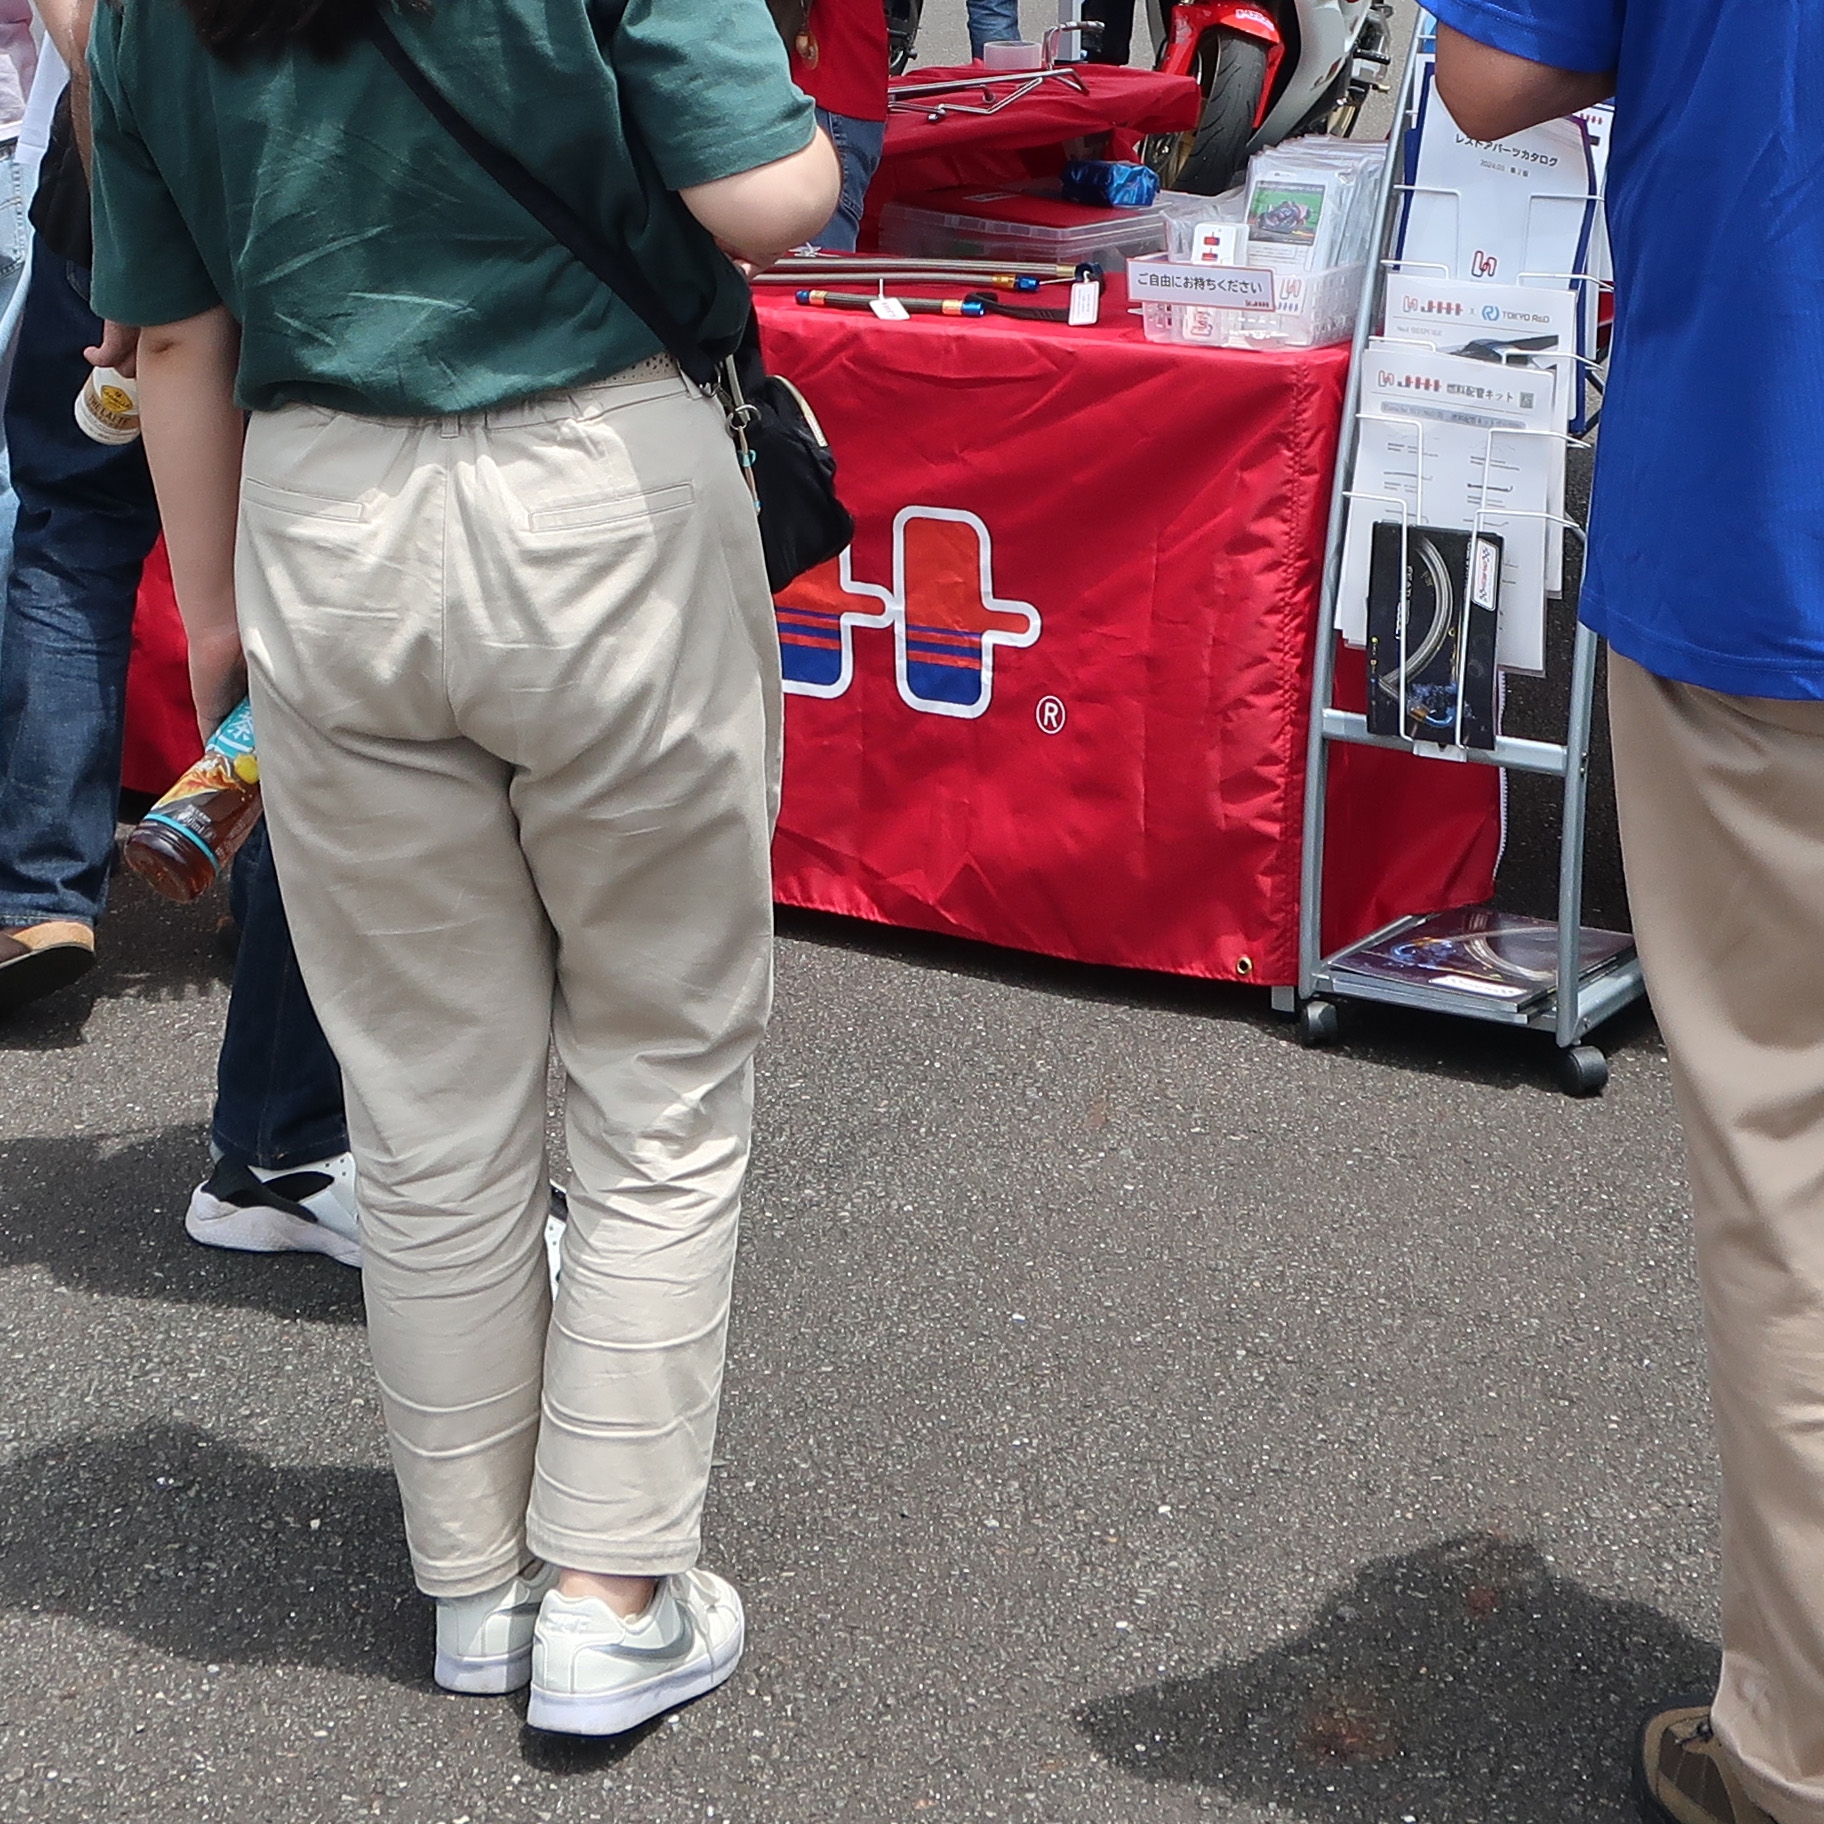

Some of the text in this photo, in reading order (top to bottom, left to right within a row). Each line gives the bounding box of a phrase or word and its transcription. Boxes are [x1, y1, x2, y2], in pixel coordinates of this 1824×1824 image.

[1137, 272, 1263, 294] ご自由にお持ちください
